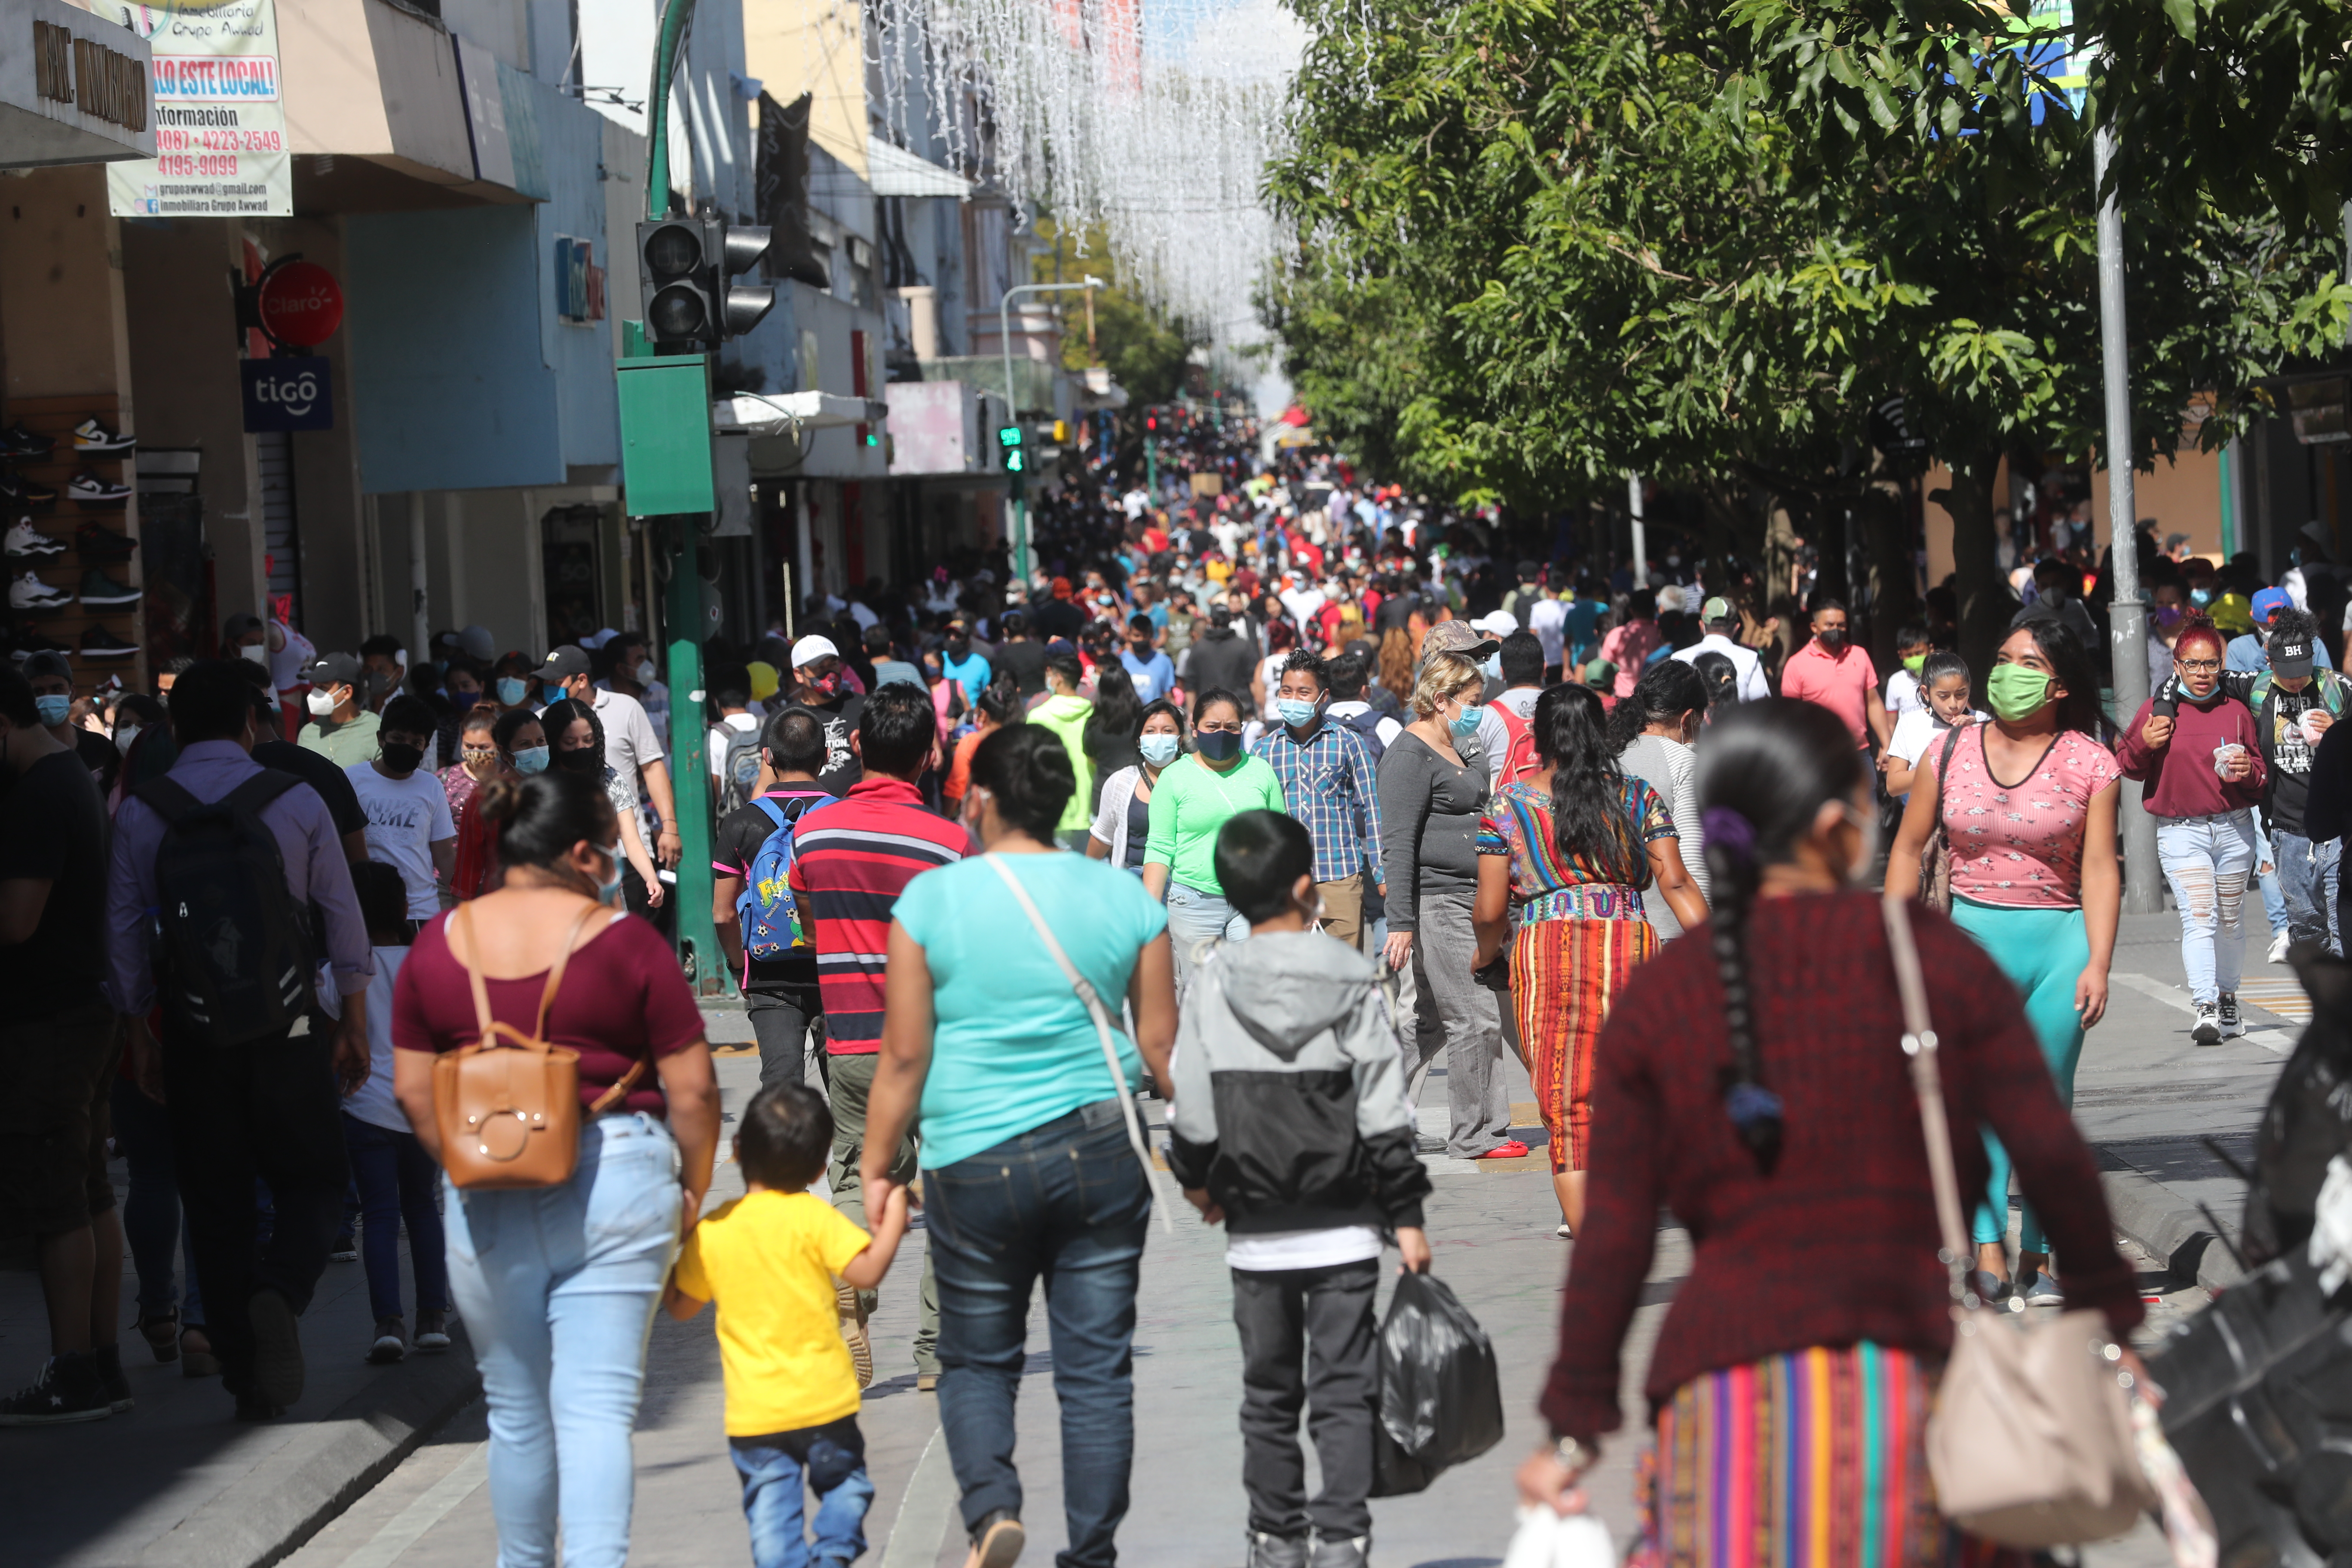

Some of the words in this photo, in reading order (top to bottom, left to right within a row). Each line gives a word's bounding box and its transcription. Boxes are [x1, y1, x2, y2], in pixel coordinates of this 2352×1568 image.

[173, 21, 212, 41] Grupo
[221, 21, 263, 37] Awwad
[179, 61, 217, 95] ESTE
[219, 61, 274, 95] LOCAL!
[203, 131, 281, 151] 4223-2549
[158, 155, 238, 175] 4195-9099
[160, 182, 266, 195] grupoawwad@gmail.com
[211, 199, 236, 211] Grupo
[239, 199, 267, 211] Awwad
[267, 297, 322, 315] Claro
[2285, 645, 2302, 656] BH
[366, 798, 422, 828] NIKE
[765, 902, 781, 920] Football
